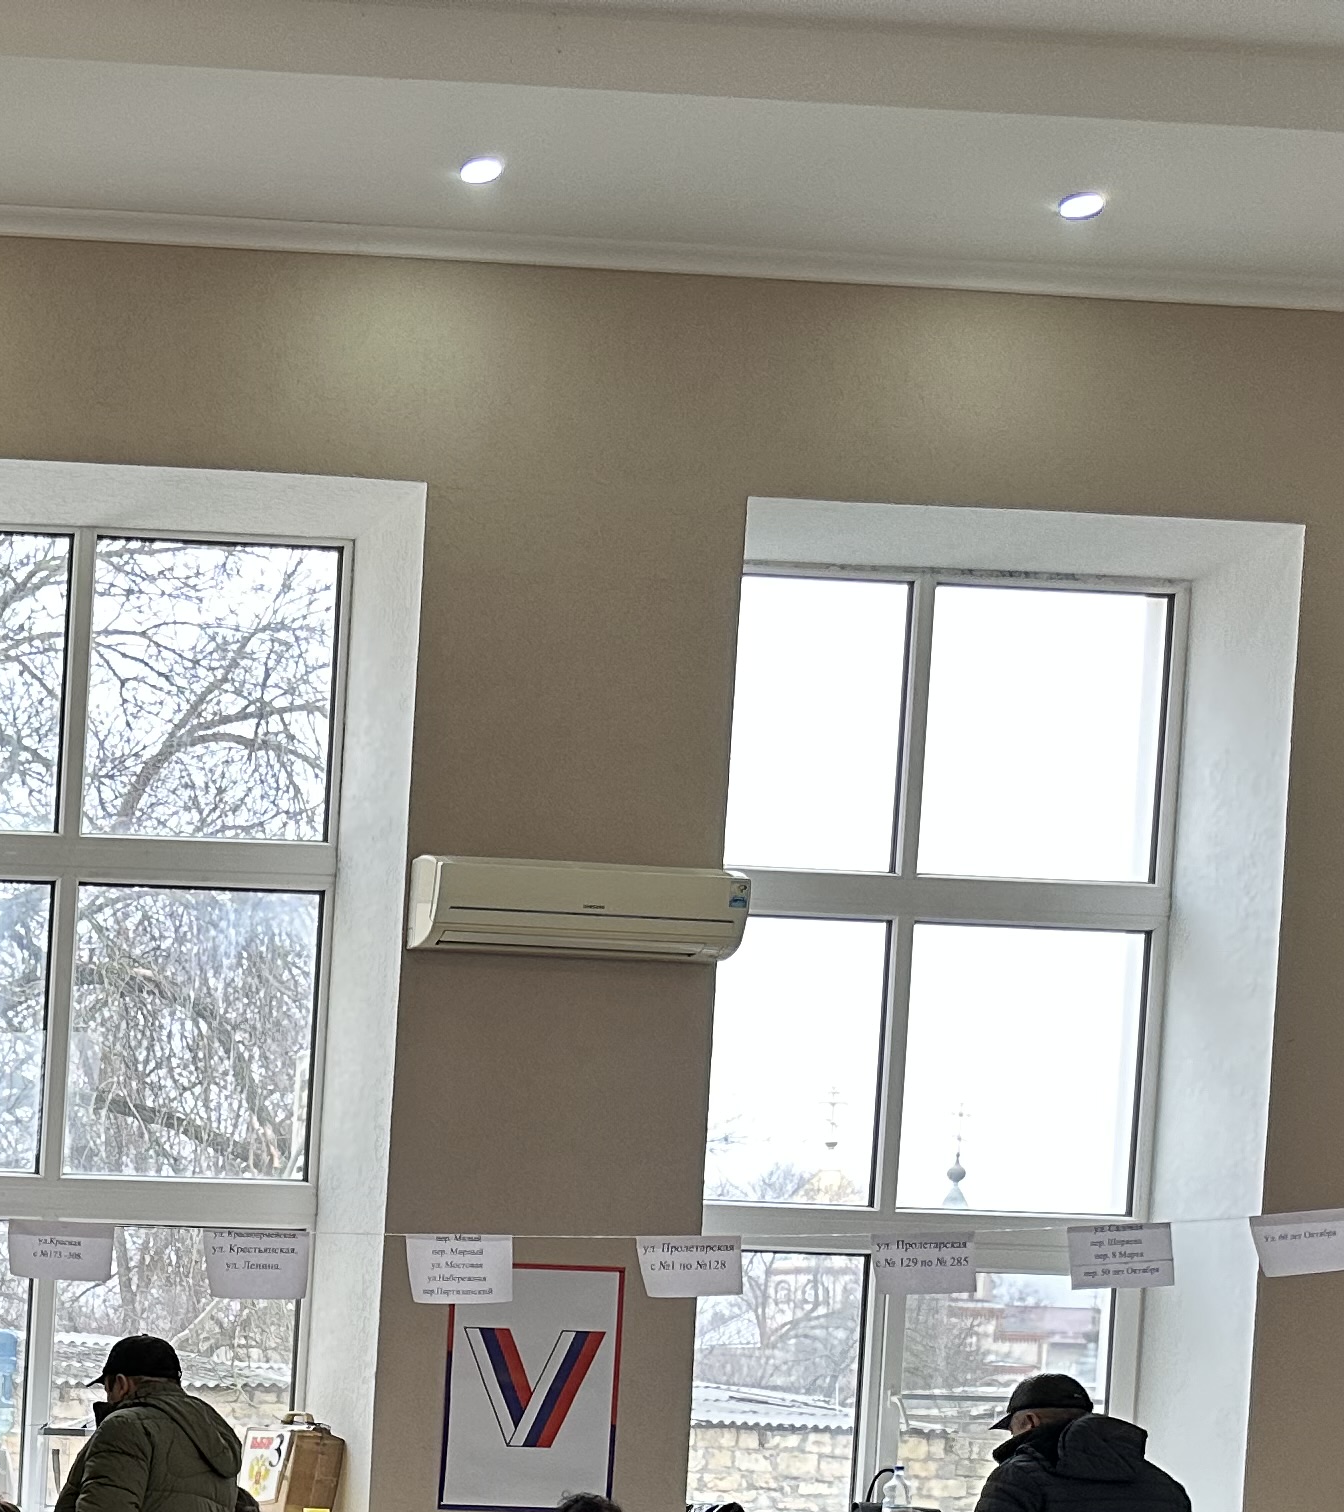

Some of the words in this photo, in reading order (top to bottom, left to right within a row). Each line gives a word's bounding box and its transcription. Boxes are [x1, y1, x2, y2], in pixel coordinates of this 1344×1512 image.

[661, 1242, 735, 1255] Пролетарская
[896, 1239, 967, 1252] Пролетарская
[679, 1262, 692, 1271] по
[900, 1257, 918, 1268] 129
[920, 1259, 933, 1268] по
[949, 1256, 969, 1267] 285
[268, 1433, 285, 1467] 3
